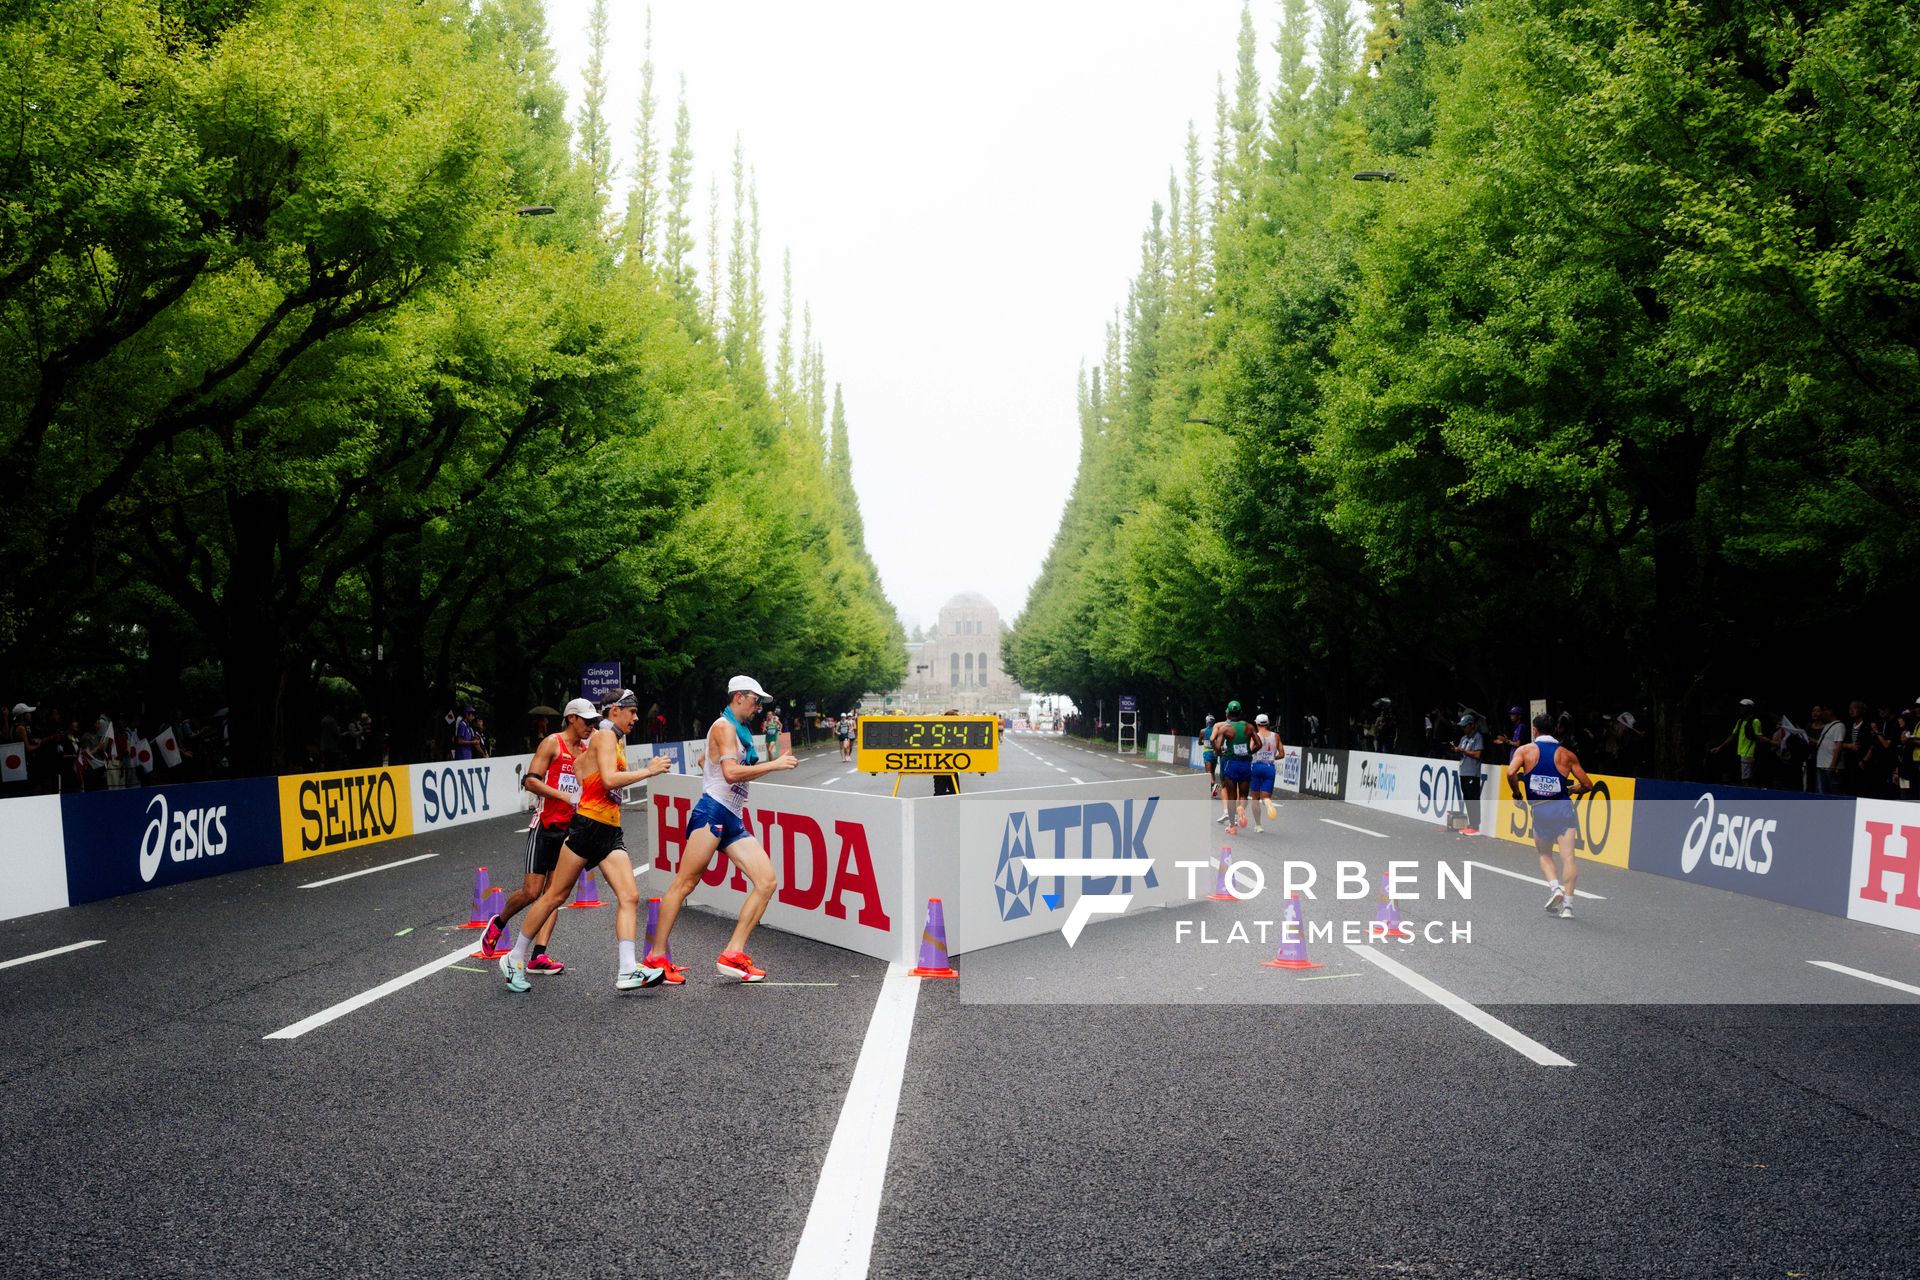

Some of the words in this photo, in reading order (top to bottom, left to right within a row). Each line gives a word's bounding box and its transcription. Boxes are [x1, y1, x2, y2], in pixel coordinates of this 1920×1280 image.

[587, 668, 614, 677] Ginkgo
[592, 687, 609, 696] Split
[886, 752, 971, 770] SEIKO
[1540, 776, 1559, 785] TDK
[422, 767, 491, 823] SONY
[299, 772, 397, 851] SEIKO
[1038, 796, 1160, 910] TDK
